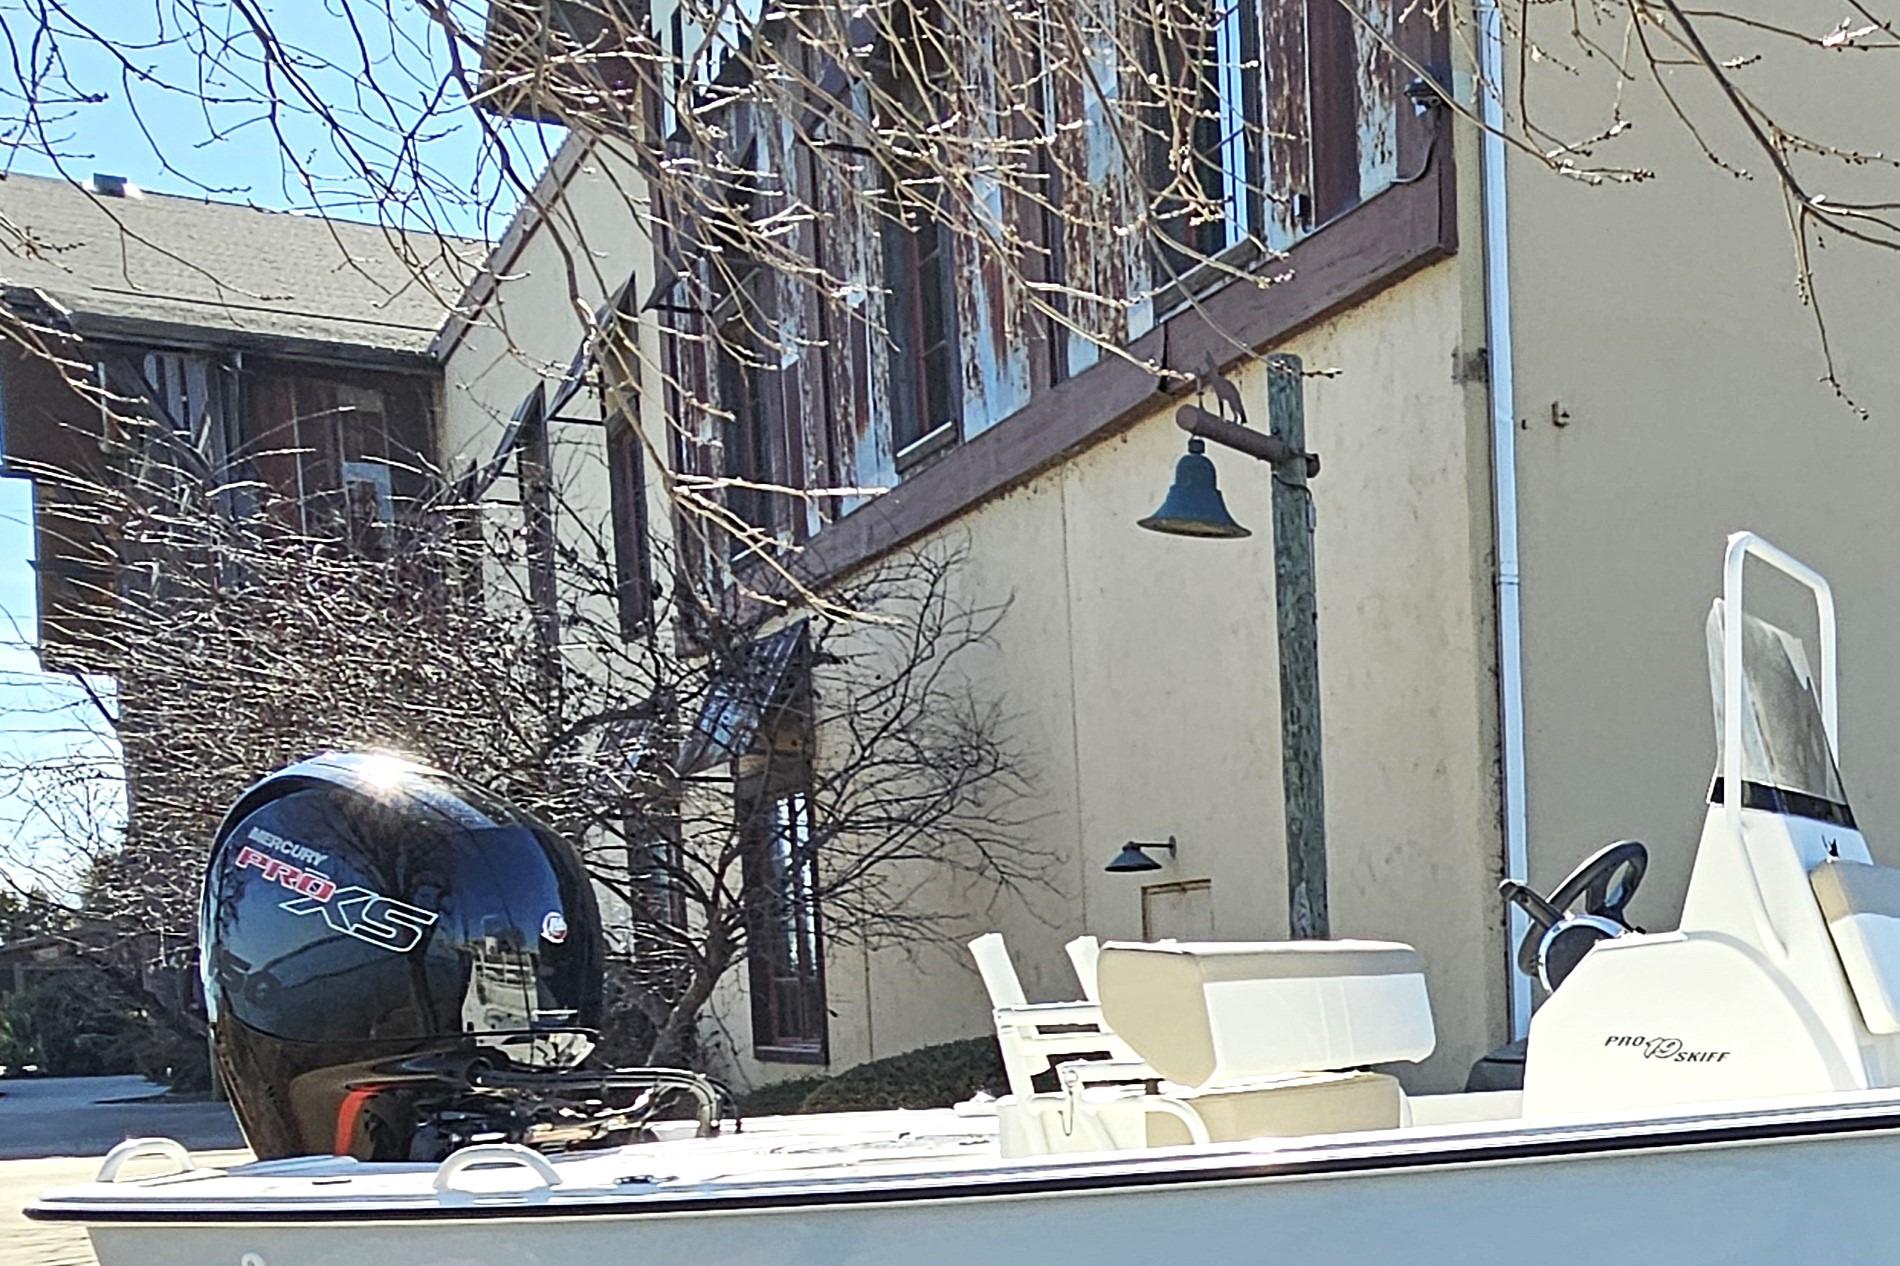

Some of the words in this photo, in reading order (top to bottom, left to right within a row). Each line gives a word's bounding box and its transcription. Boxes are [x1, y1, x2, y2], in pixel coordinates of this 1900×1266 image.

[248, 826, 328, 867] MERCURY
[235, 846, 337, 904] PRO
[278, 885, 440, 952] XS
[1604, 1035, 1646, 1047] PRO
[1673, 1051, 1732, 1062] SKIFF
